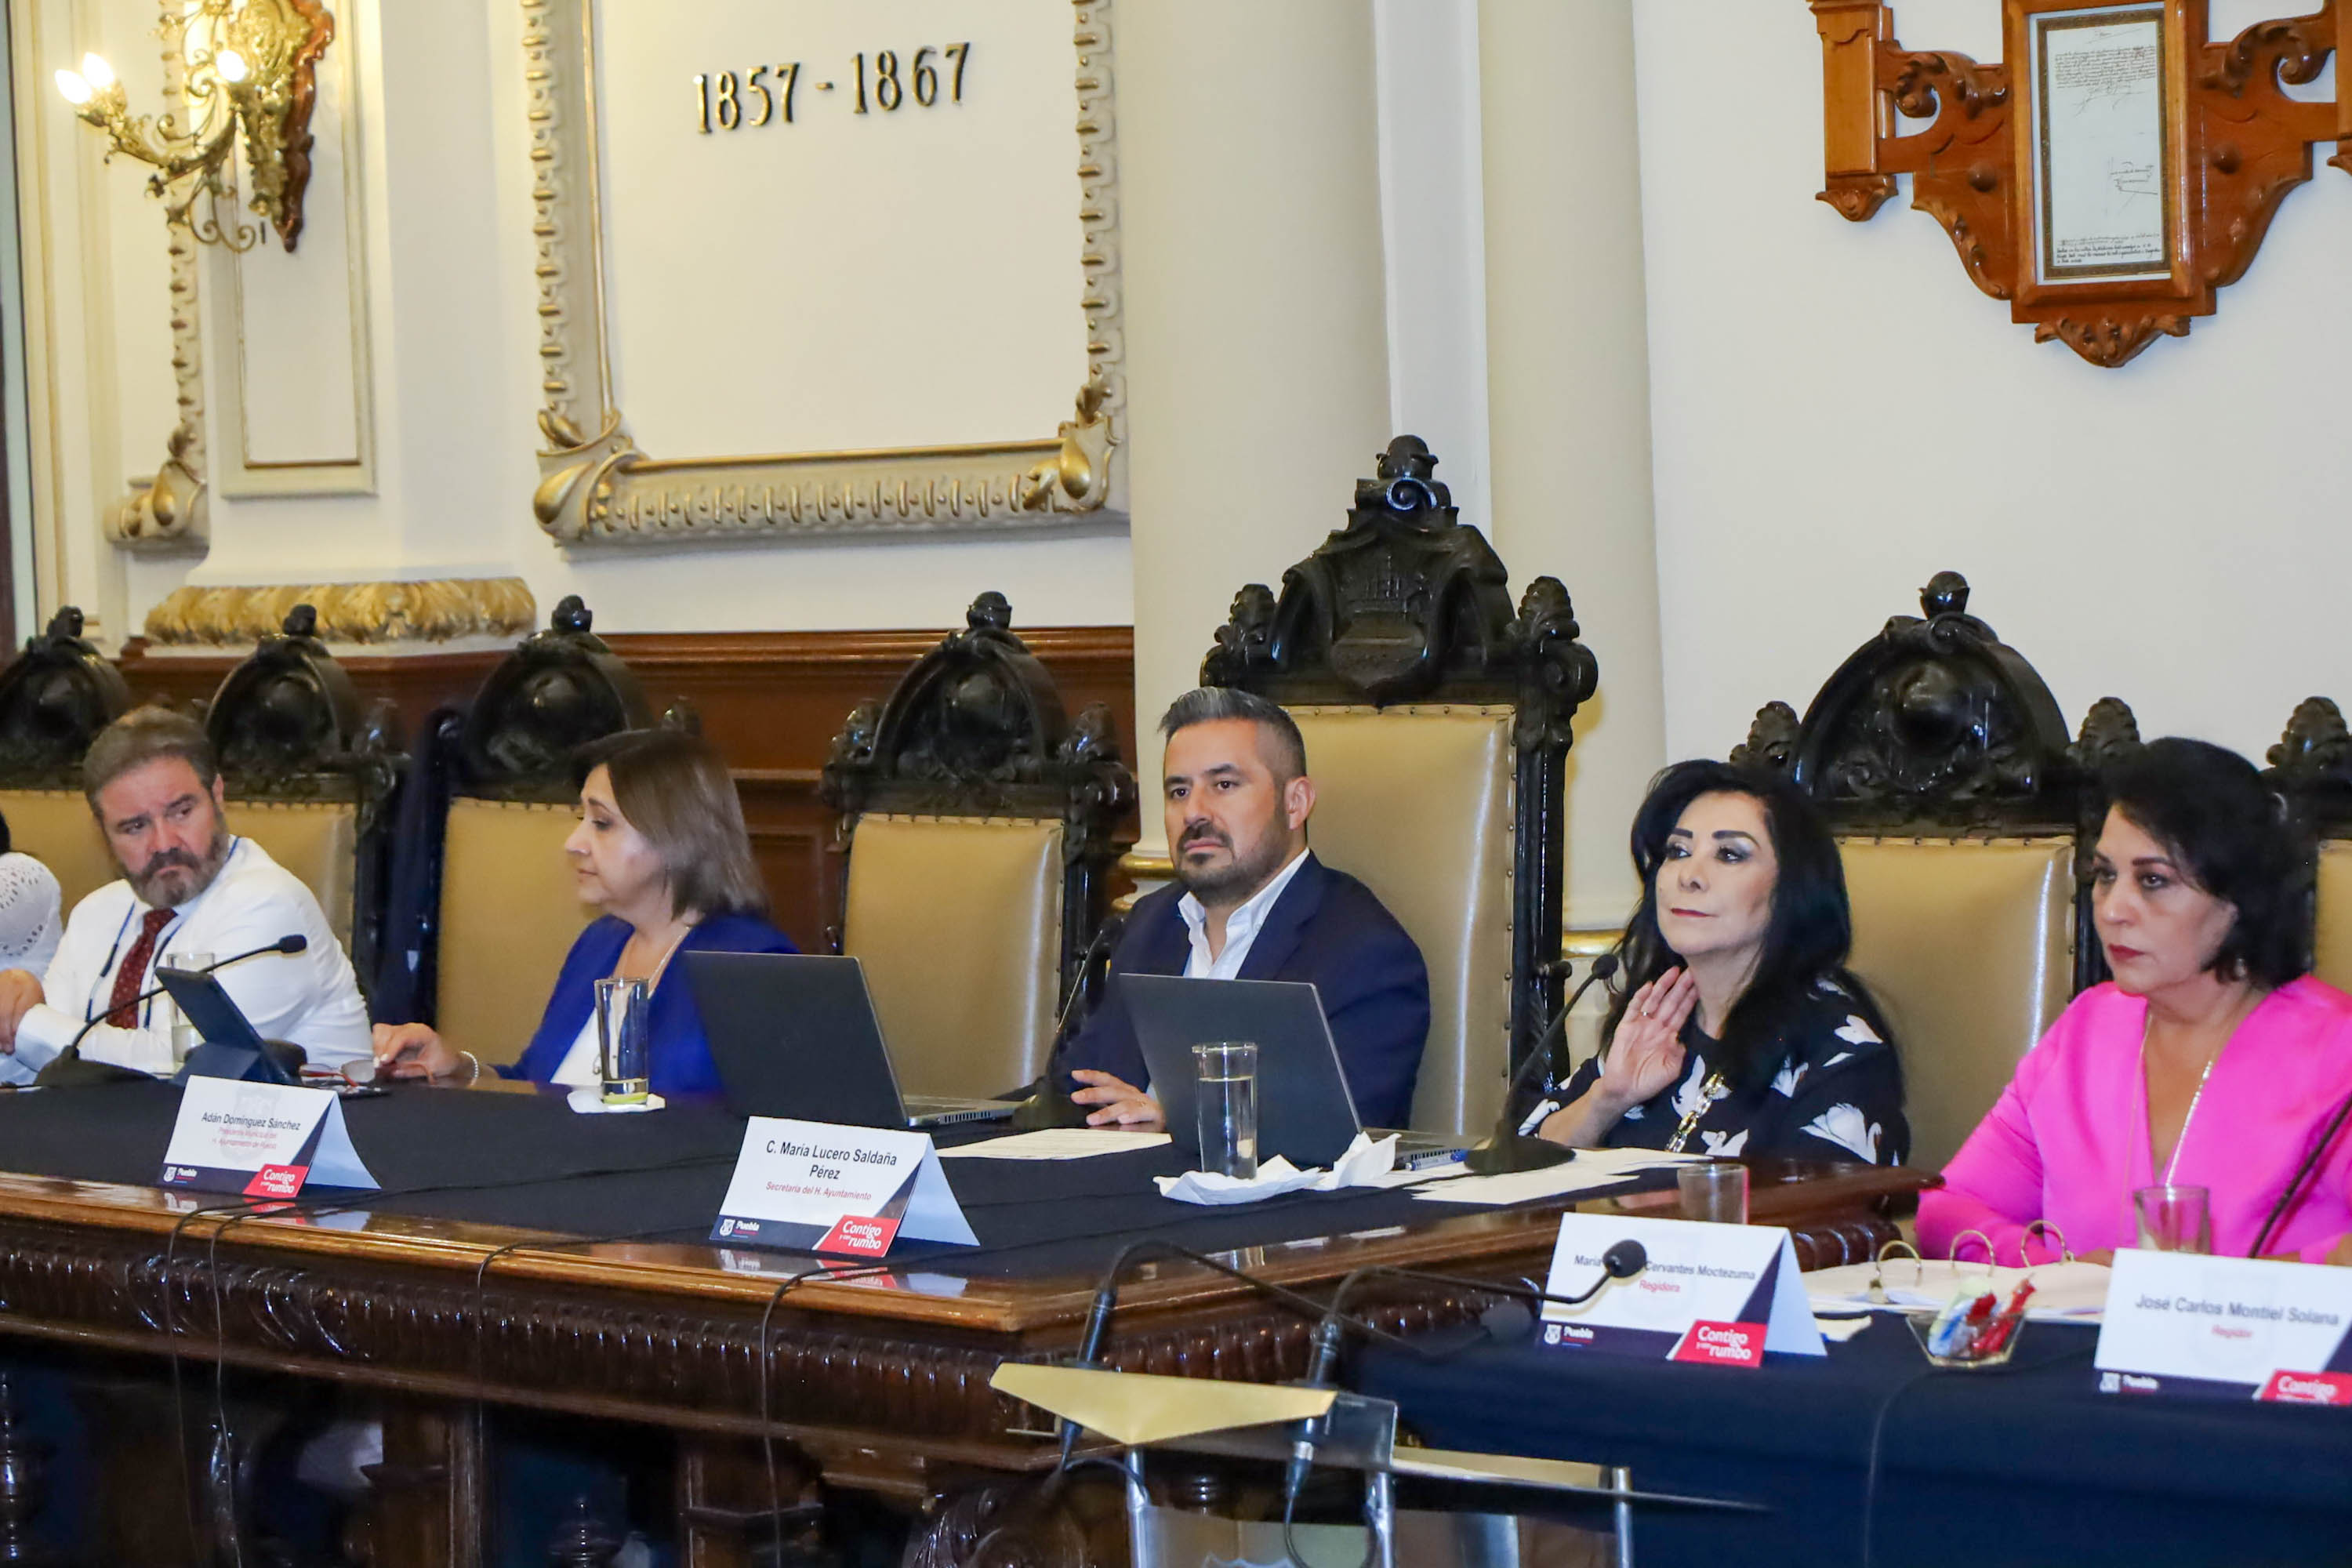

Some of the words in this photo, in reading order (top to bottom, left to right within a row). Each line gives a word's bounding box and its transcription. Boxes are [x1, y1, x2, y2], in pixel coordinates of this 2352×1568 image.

[692, 62, 800, 134] 1857
[850, 42, 971, 114] 1867
[766, 1140, 776, 1153] C.
[780, 1142, 810, 1157] María
[812, 1145, 851, 1161] Lucero
[853, 1149, 898, 1166] Saldaña
[263, 1168, 296, 1185] Contigo
[809, 1164, 840, 1180] Pérez
[267, 1182, 295, 1194] rumbo
[802, 1185, 813, 1194] del
[814, 1186, 822, 1196] H.
[823, 1188, 872, 1200] Ayuntamiento
[843, 1221, 882, 1240] Contigo
[848, 1237, 882, 1250] rumbo
[1645, 1260, 1694, 1275] Cervantes
[1697, 1264, 1755, 1280] Moctezuma
[1639, 1279, 1681, 1293] Regidora
[2175, 1297, 2223, 1316] Carlos
[2228, 1301, 2284, 1320] Montiel
[2287, 1307, 2339, 1326] Solana
[1697, 1325, 1749, 1347] Contigo
[1709, 1345, 1752, 1360] rumbo
